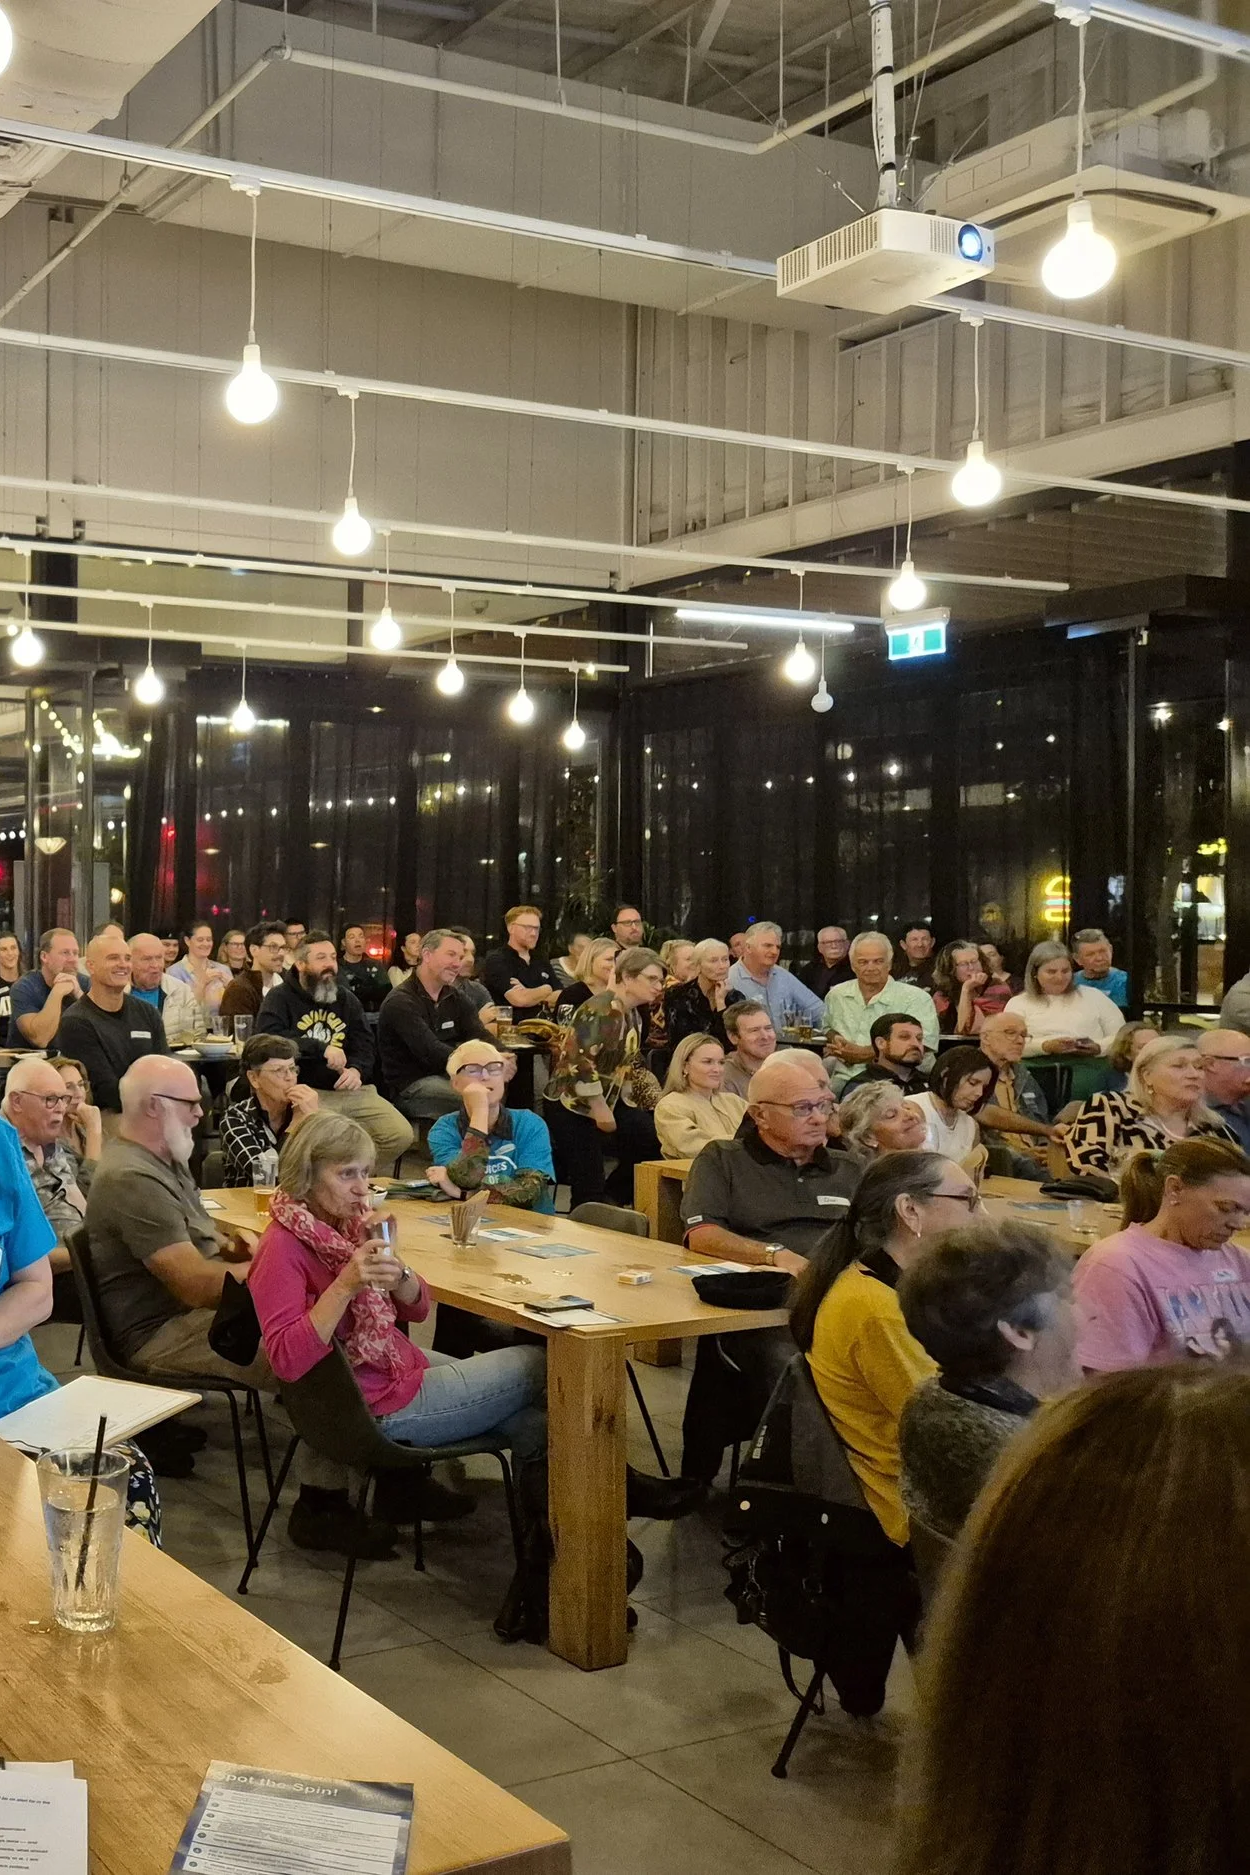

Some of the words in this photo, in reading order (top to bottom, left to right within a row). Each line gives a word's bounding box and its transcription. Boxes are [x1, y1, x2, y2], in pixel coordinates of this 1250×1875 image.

[215, 1769, 255, 1784] Spot
[258, 1776, 287, 1789] the
[293, 1782, 339, 1797] Spin!
